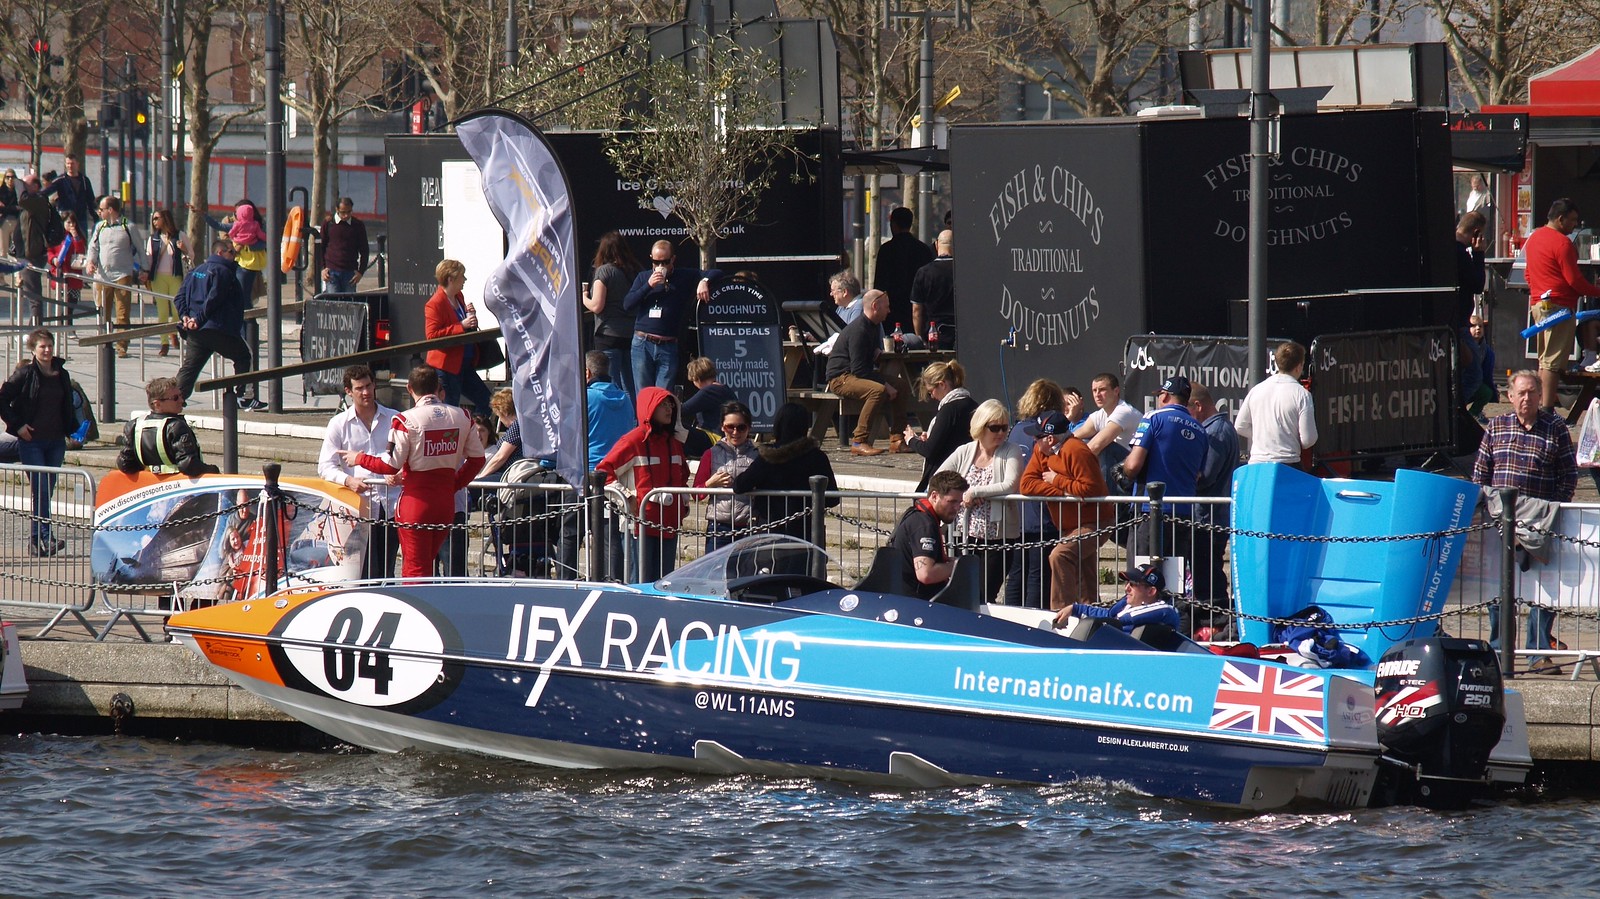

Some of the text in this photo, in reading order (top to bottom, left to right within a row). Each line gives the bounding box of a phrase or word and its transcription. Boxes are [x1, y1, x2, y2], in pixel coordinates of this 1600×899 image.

[1292, 147, 1363, 183] CHIPS
[617, 179, 640, 191] Ice
[1233, 185, 1334, 202] TRDITIONAL
[989, 164, 1104, 246] FISH & CHIPS
[1214, 212, 1352, 246] DOGHNUTS
[1011, 248, 1083, 273] TRADITIONAL
[394, 282, 415, 295] BURGERS
[418, 283, 428, 296] HOT
[711, 284, 764, 300] ICE CREAM TIME
[708, 304, 767, 315] DOUGHNUTS
[1000, 284, 1100, 346] DOUGHNUTS
[708, 327, 771, 336] MEAL DEALS
[734, 339, 748, 358] 5
[715, 357, 769, 372] freshly made
[1339, 358, 1430, 385] TRADITIONAL
[716, 371, 776, 388] OUGHNUTS
[1328, 388, 1437, 425] FISH & CHIPS
[98, 481, 181, 518] www.discovergosport.co.uk
[1426, 571, 1443, 599] PILOT
[1439, 540, 1453, 565] NICK
[322, 606, 402, 696] 04
[506, 590, 801, 707] IFX RACING
[1377, 659, 1421, 678] EVINRUDE
[953, 666, 1193, 714] Internationalfx.com
[1459, 683, 1494, 693] EVINRUDE
[695, 691, 795, 718] @WL11AMS
[1464, 694, 1491, 706] 250
[1098, 735, 1189, 753] DESIGN ALEXLAMBERT.CO.UK
